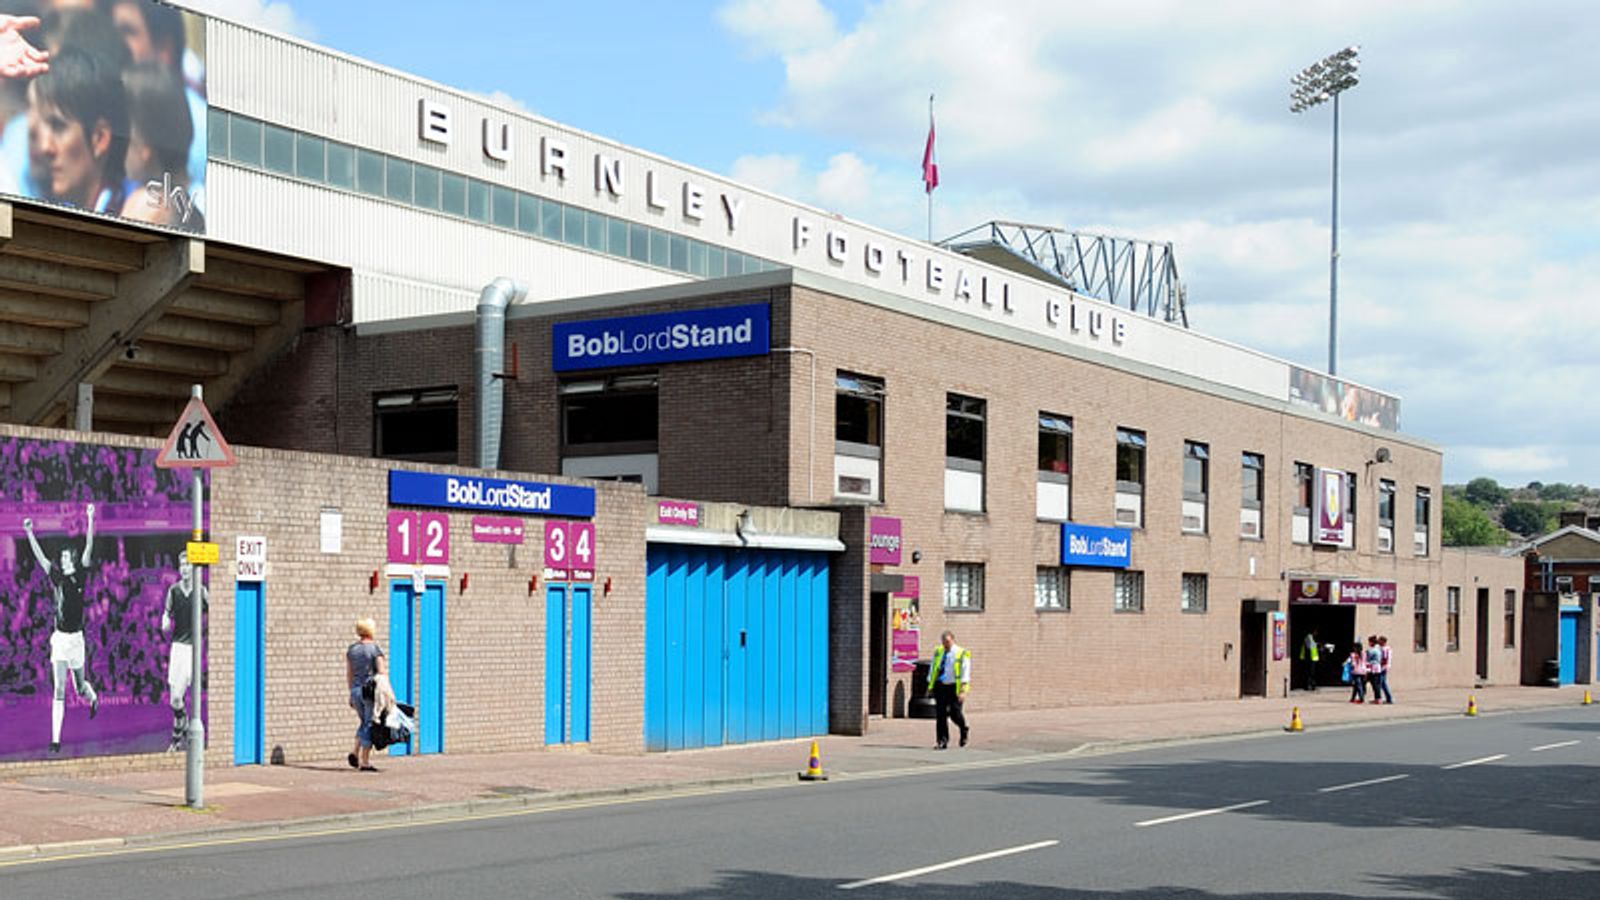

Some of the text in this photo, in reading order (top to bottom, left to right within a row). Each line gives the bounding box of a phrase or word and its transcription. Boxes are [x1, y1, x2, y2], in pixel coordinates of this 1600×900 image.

[145, 172, 198, 223] sky
[418, 98, 1129, 345] BURNLEY FOOTBALL CLUB
[567, 317, 752, 358] BobLordStand
[446, 477, 551, 510] BobLordStand
[239, 540, 263, 556] EXIT
[397, 518, 410, 556] 1
[425, 519, 444, 558] 2
[549, 527, 566, 562] 3
[574, 528, 592, 563] 4
[238, 560, 265, 575] ONLY
